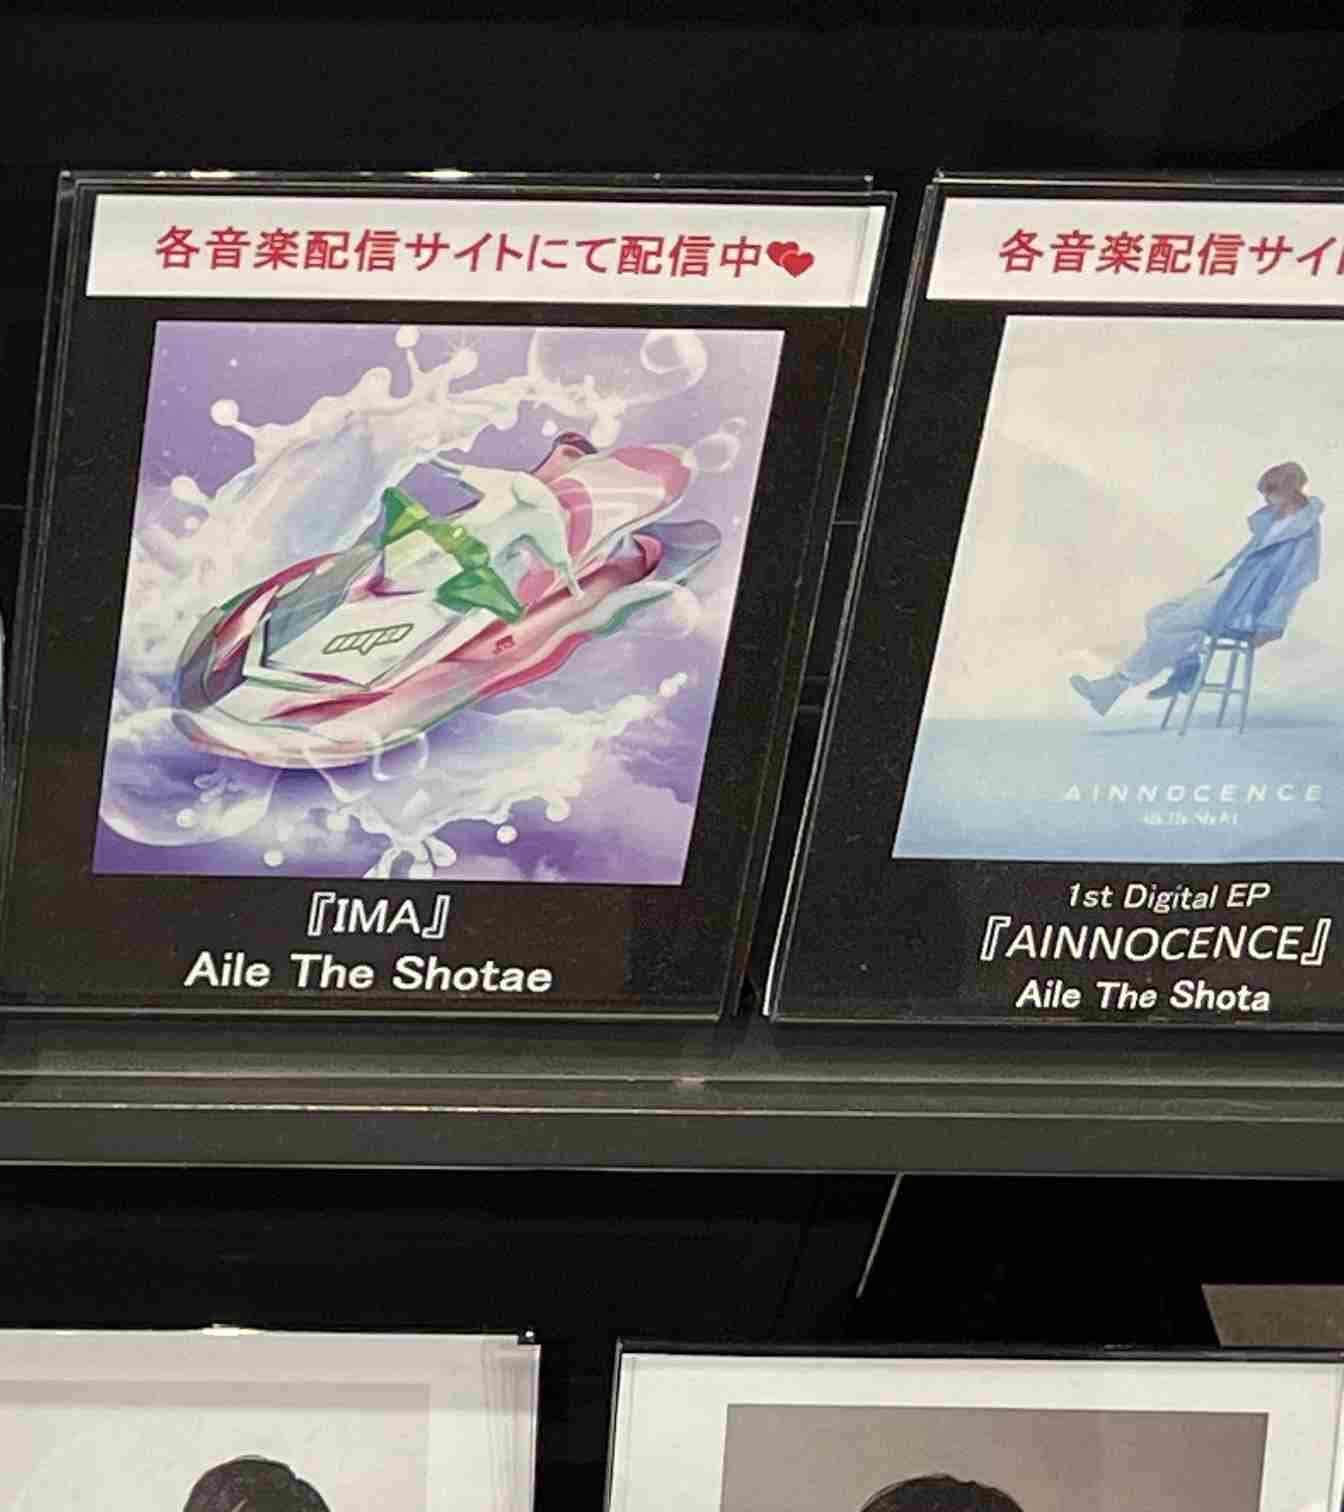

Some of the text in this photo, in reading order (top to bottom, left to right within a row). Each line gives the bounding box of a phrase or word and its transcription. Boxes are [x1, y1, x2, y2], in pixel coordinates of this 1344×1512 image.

[155, 225, 762, 278] 各音楽配信サイトにて配信中
[1069, 882, 1271, 914] 1st Digital EP
[184, 951, 553, 993] Aile The Shotae
[1015, 979, 1270, 1012] Aile The Shota
